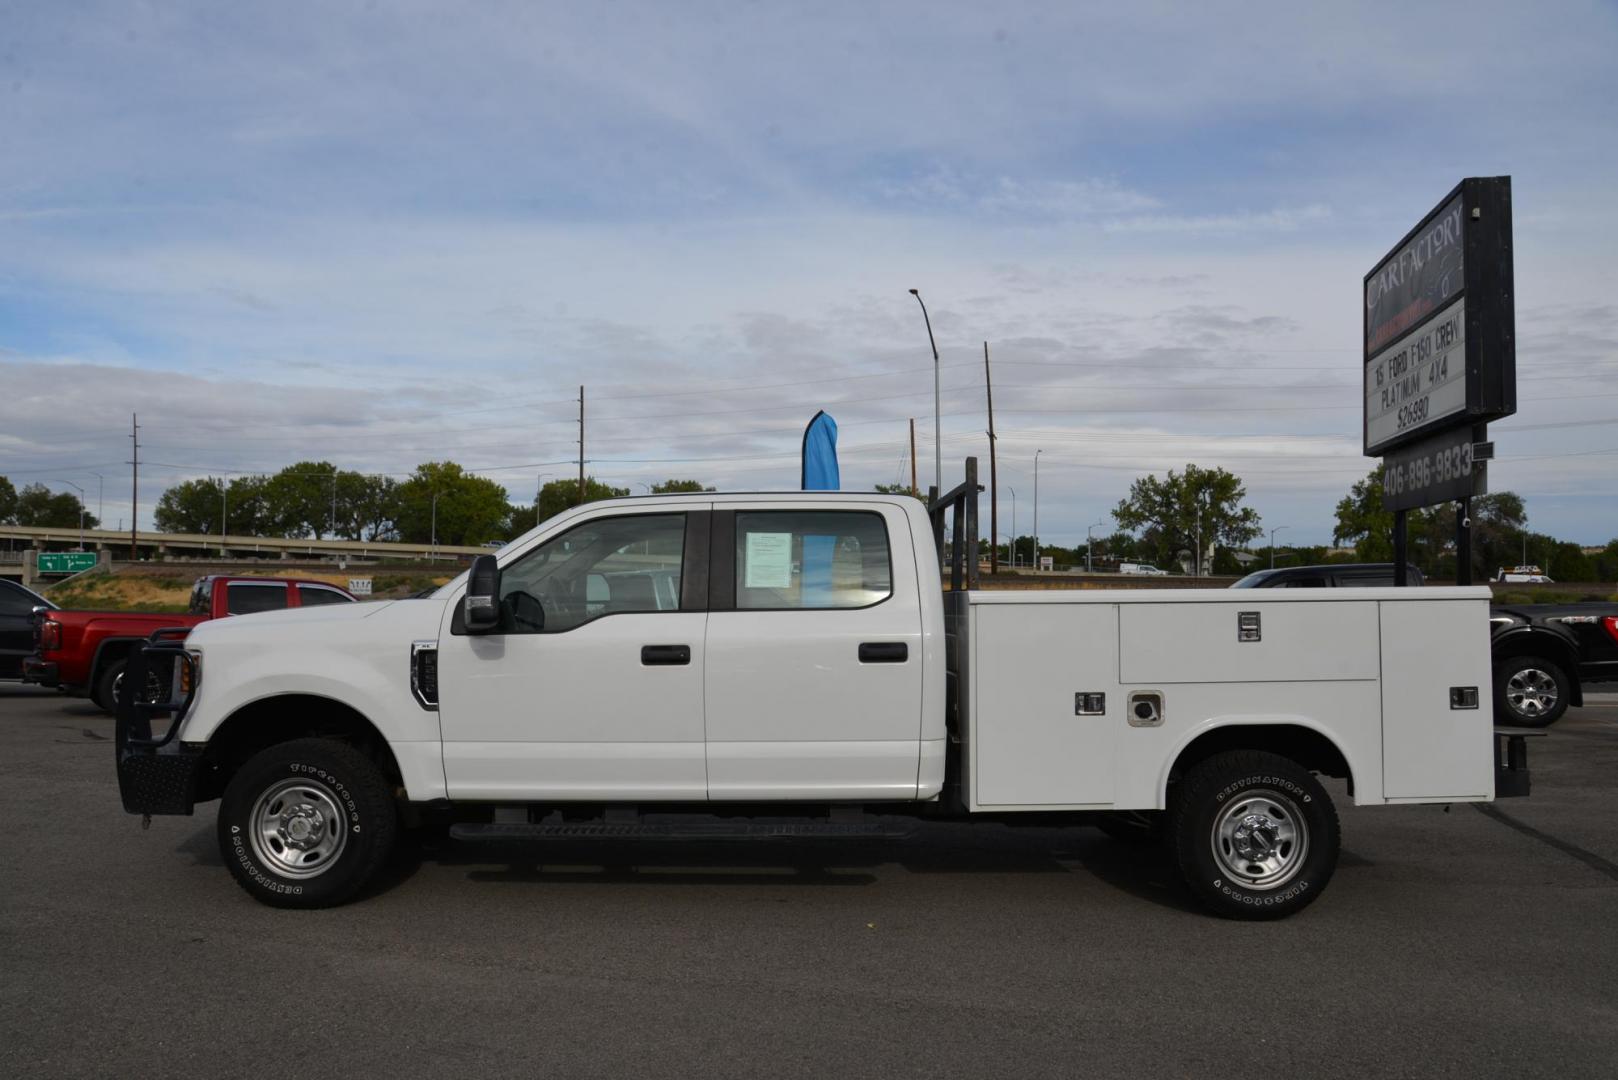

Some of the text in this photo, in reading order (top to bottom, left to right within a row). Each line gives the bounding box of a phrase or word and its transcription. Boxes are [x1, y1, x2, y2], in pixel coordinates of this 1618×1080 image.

[1388, 350, 1408, 380] FORD
[1411, 335, 1432, 367] F150
[1435, 314, 1459, 351] CREW
[1381, 355, 1448, 411] PLATINUM 4X4
[1383, 442, 1472, 497] 406-896-9833
[1216, 776, 1304, 802] DESTINATION
[231, 835, 303, 894] DESTINATION
